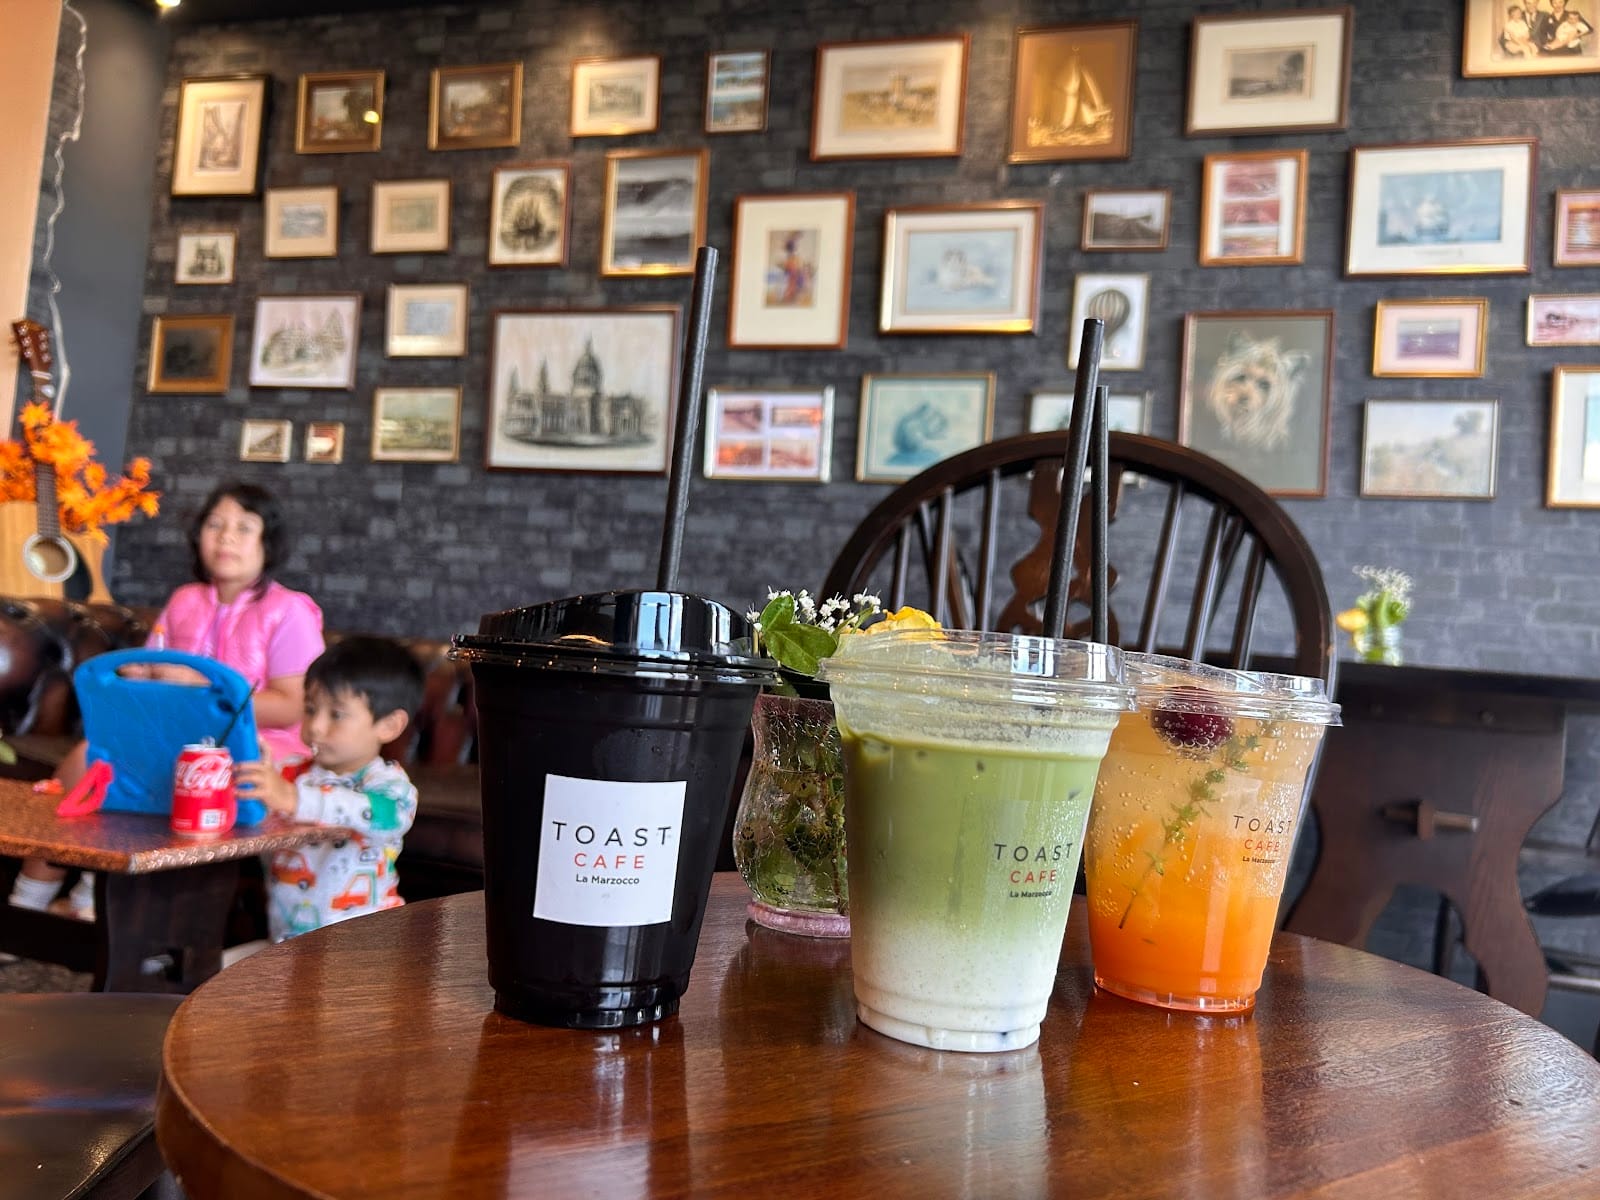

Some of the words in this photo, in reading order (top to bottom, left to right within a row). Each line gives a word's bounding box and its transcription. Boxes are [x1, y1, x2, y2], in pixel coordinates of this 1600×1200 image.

[1233, 815, 1292, 834] TOAST
[552, 820, 672, 847] TOAST
[994, 842, 1073, 862] TOAST
[1244, 838, 1280, 852] CAFE
[574, 852, 645, 869] CAFE
[1251, 856, 1276, 864] Marz
[576, 874, 588, 883] La
[591, 875, 640, 885] Marzocco
[1010, 869, 1057, 883] CAFE
